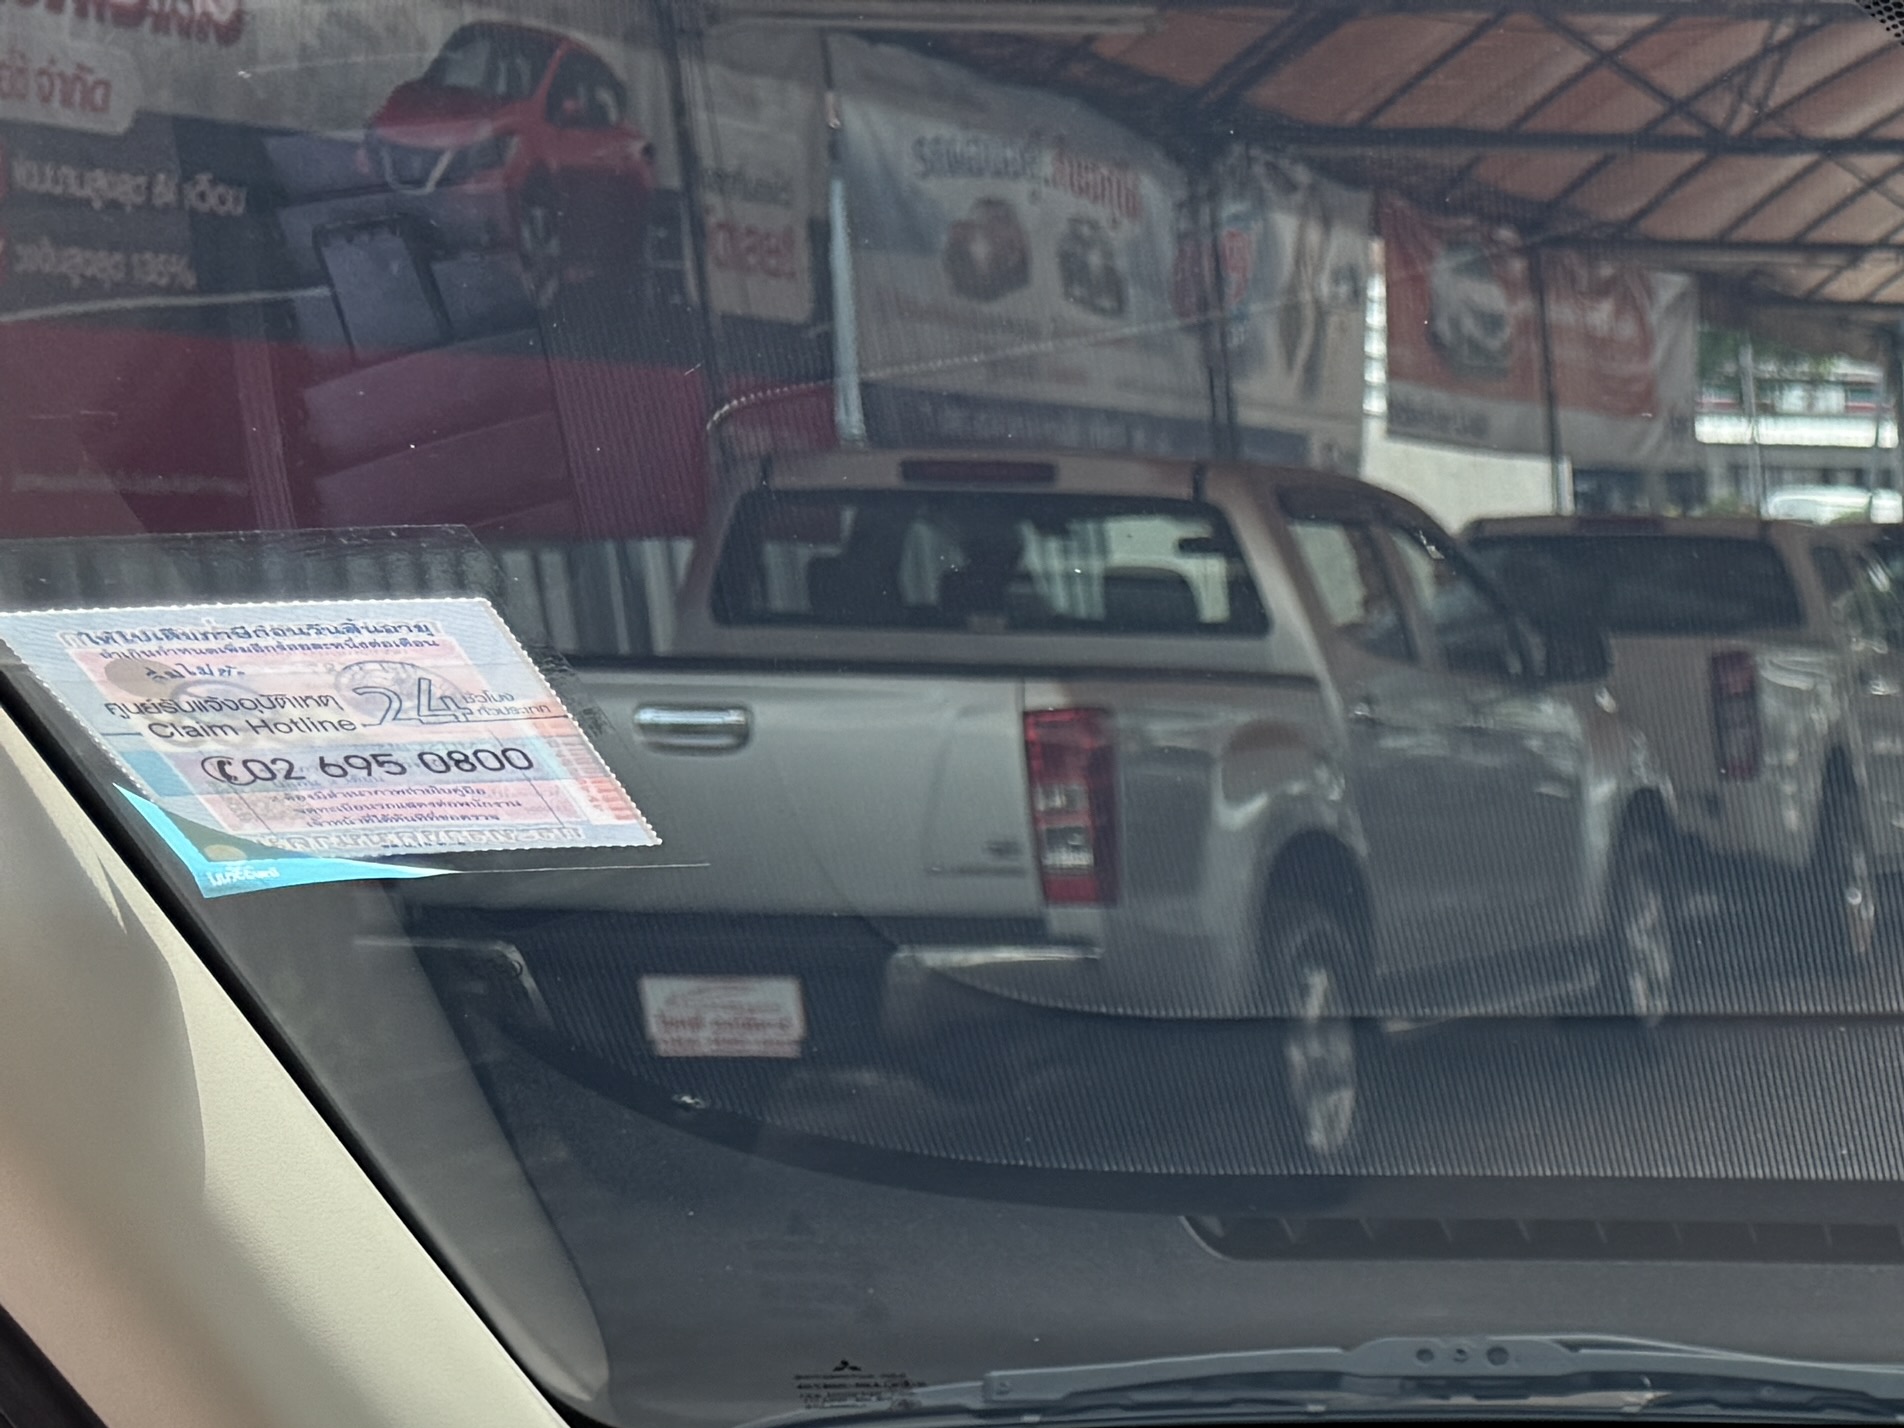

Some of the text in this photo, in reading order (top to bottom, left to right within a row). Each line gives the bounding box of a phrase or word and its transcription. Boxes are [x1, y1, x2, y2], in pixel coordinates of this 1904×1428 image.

[148, 715, 357, 740] Claim Hotline
[318, 752, 407, 779] 695
[418, 747, 534, 774] 0800
